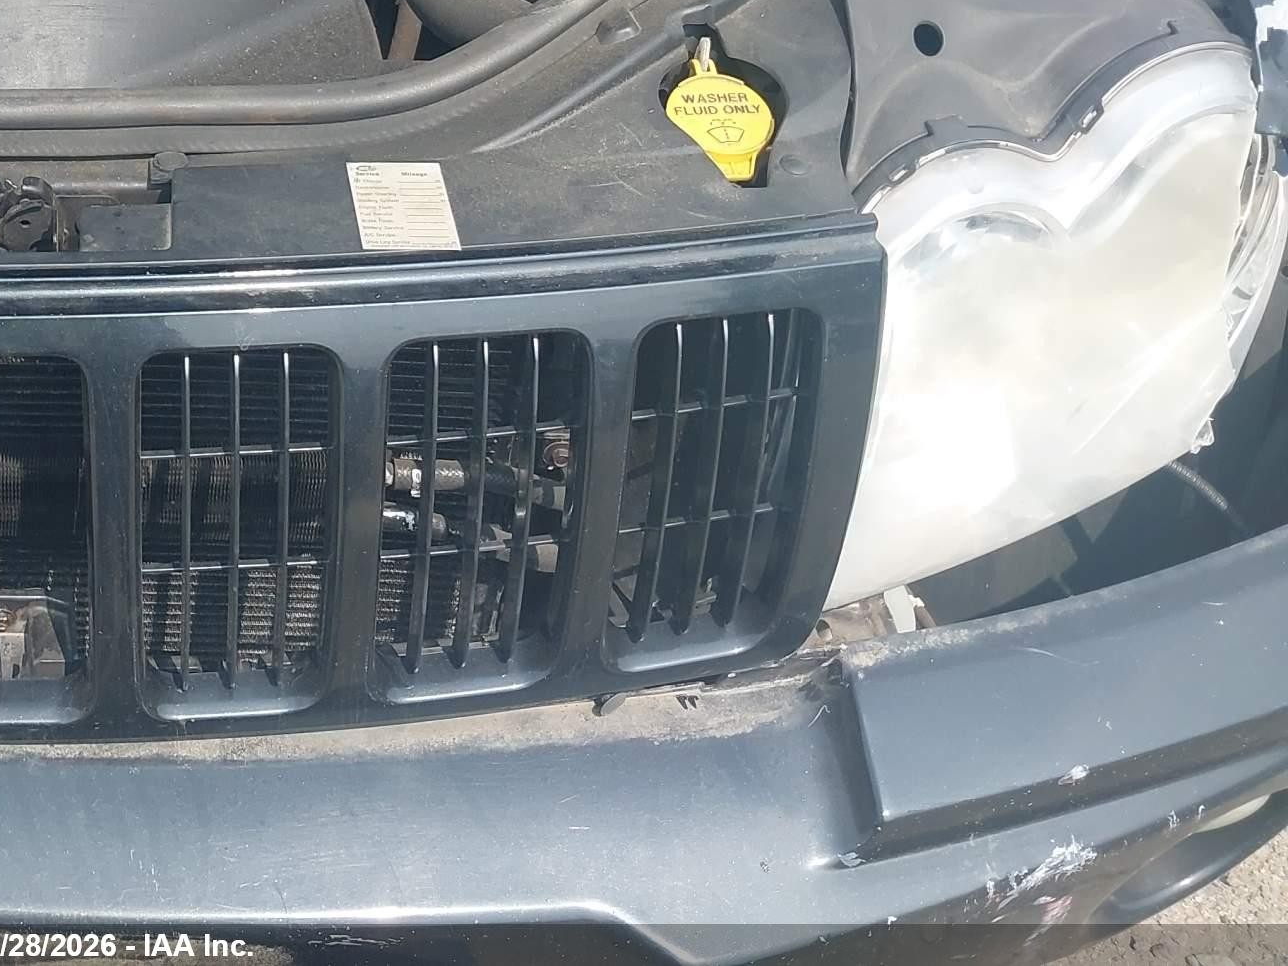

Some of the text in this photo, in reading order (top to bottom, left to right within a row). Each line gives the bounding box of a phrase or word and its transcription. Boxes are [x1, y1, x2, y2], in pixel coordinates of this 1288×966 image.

[680, 92, 749, 104] WASHER
[674, 104, 761, 116] FLUID ONLY
